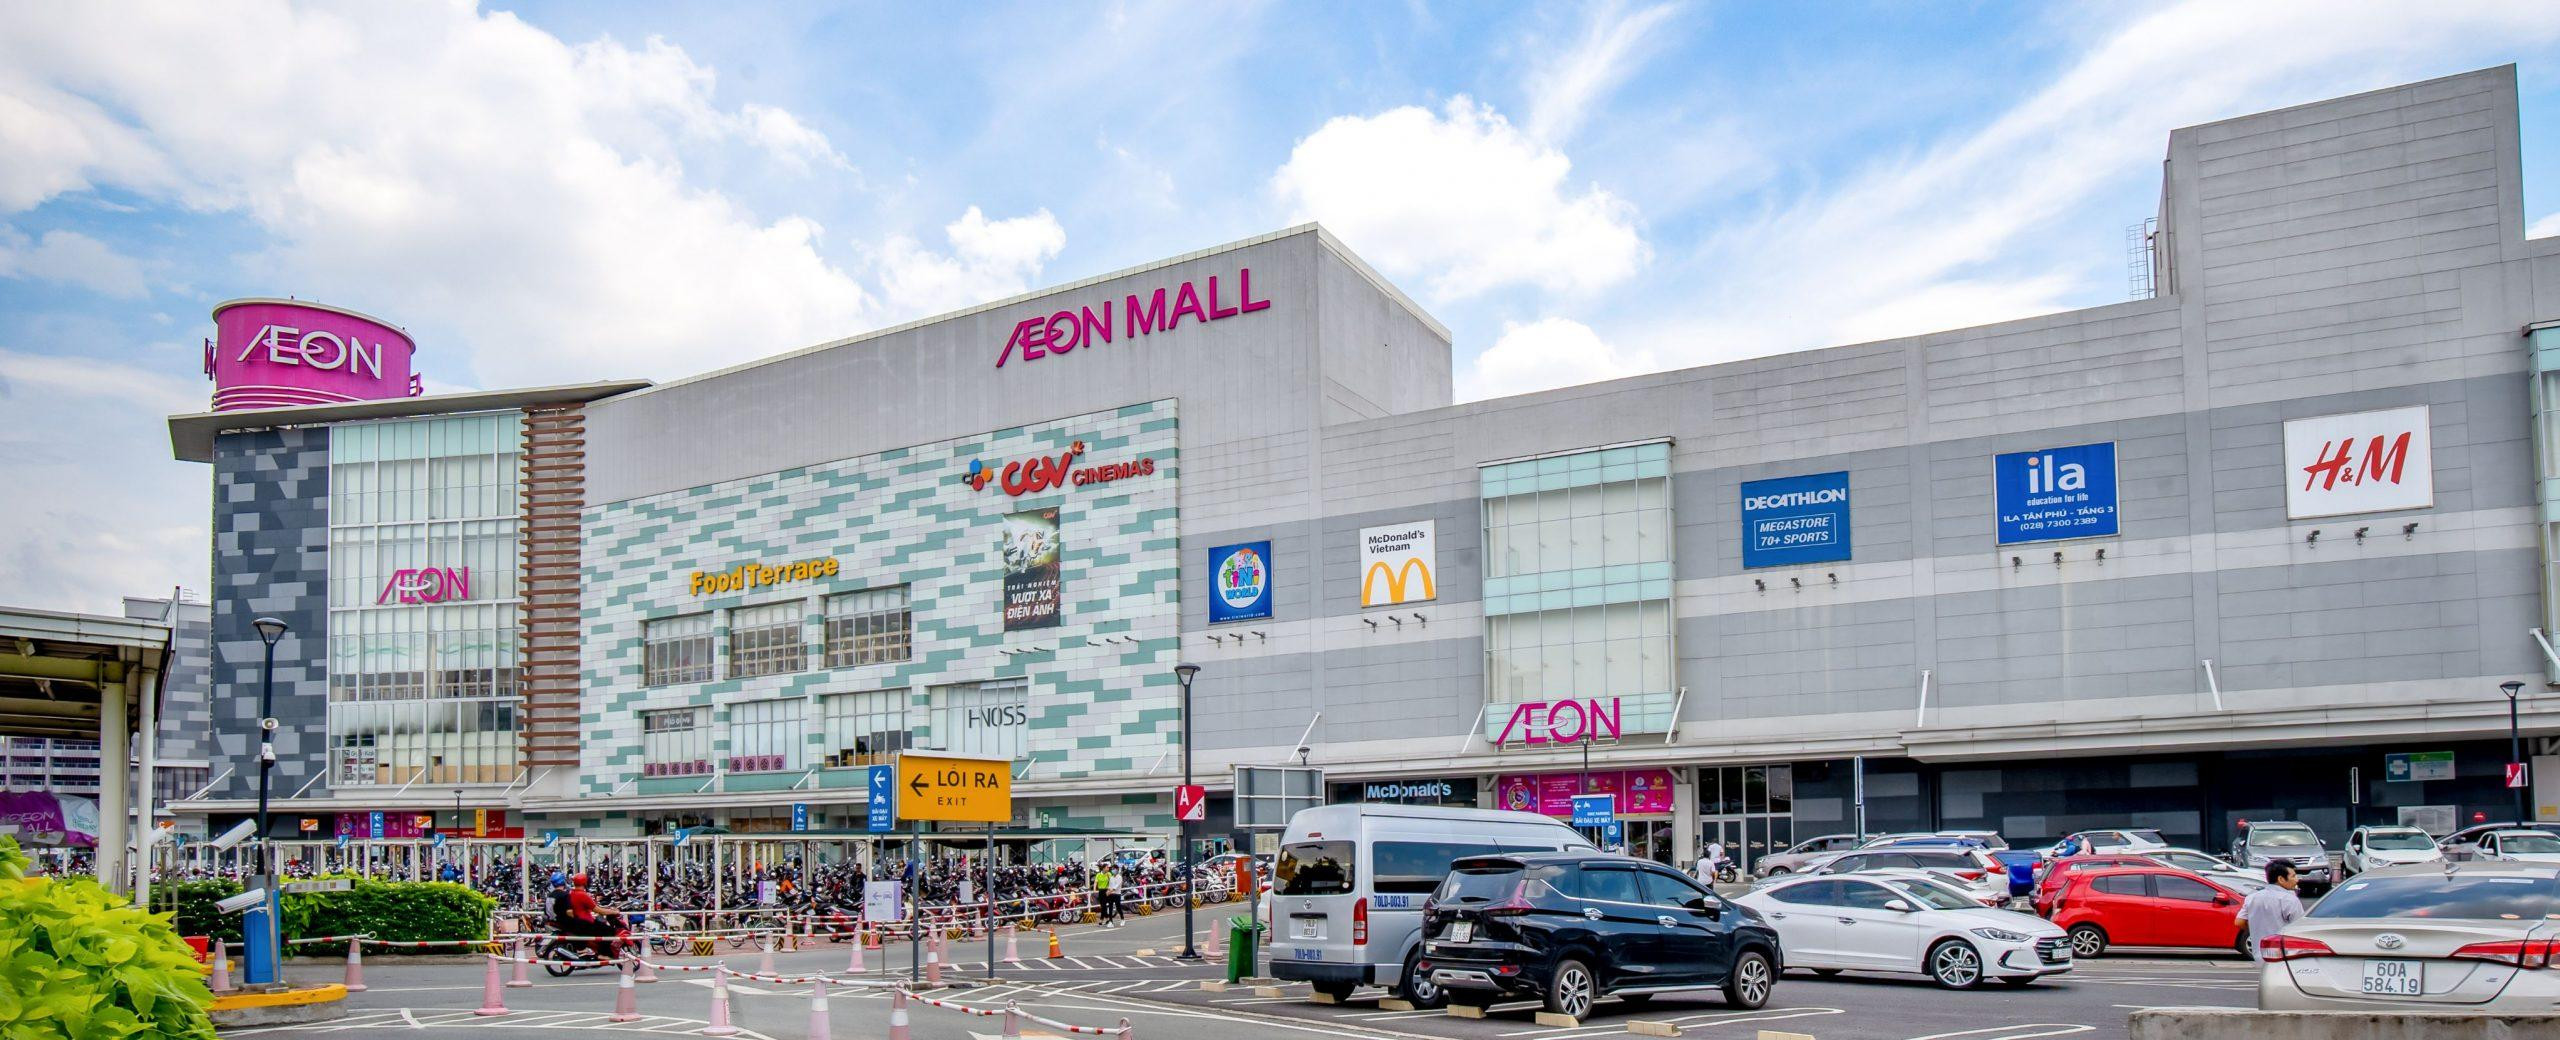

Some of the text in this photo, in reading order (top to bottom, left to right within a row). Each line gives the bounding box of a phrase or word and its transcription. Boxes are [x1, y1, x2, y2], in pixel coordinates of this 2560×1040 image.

[1126, 268, 1271, 340] MALL
[2303, 431, 2411, 492] H&M
[1001, 452, 1155, 497] CGV CINEMAS
[2027, 454, 2086, 494] ila
[1744, 487, 1847, 511] DECATHLON
[2027, 492, 2089, 507] education for life
[2003, 515, 2021, 523] ILA
[2107, 505, 2114, 513] 3
[1759, 516, 1831, 533] MEGASTORE
[2020, 516, 2098, 532] (028) 7300 2389
[1368, 529, 1425, 545] McDonald's
[1760, 531, 1830, 547] 70+ SPORTS
[1369, 543, 1411, 554] Vietnam
[745, 556, 840, 589] Terrace
[1038, 589, 1053, 601] XA
[1225, 586, 1259, 600] WORLD
[937, 763, 1000, 789] LỐI RA
[1179, 786, 1190, 806] A
[1366, 782, 1452, 799] McDonald's
[937, 796, 968, 807] EXIT
[1197, 803, 1203, 818] 3
[2376, 962, 2406, 977] 60A
[2364, 976, 2418, 993] 584.19
